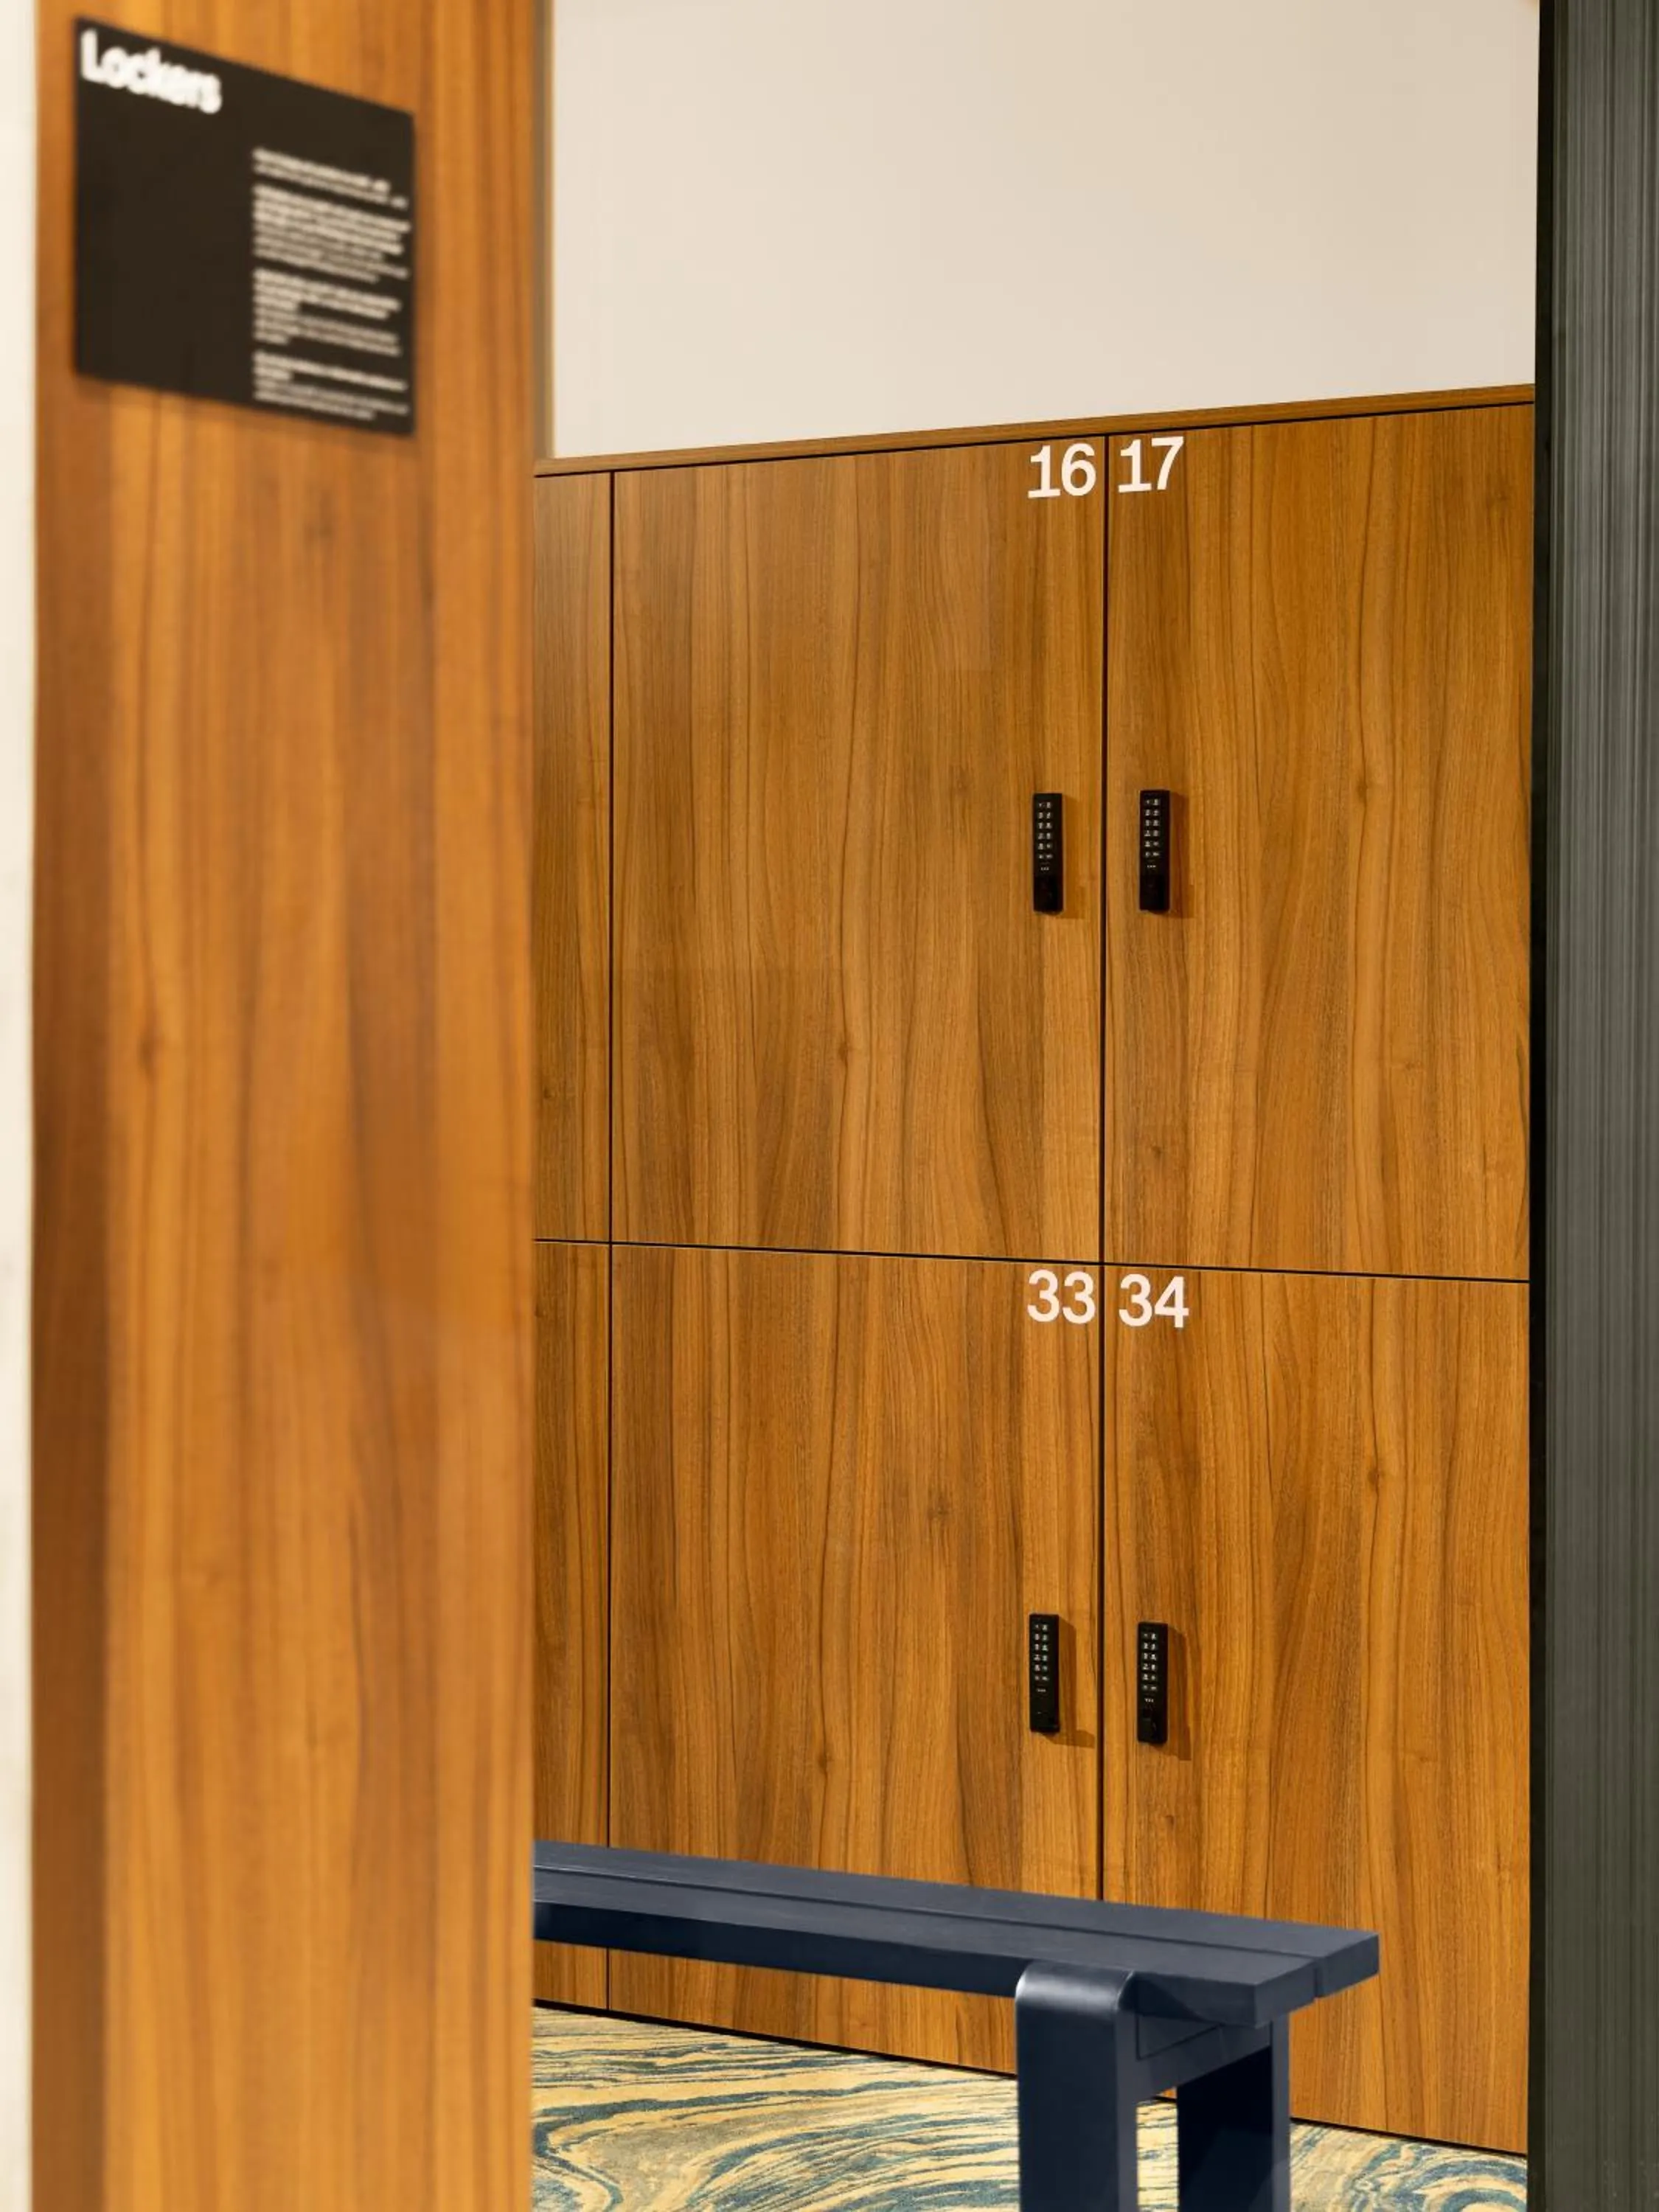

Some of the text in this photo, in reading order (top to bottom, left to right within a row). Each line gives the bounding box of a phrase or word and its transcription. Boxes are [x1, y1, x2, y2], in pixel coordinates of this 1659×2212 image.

[1028, 442, 1096, 499] 16
[1118, 436, 1184, 493] 17
[1027, 1269, 1096, 1324] 33
[1119, 1273, 1189, 1328] 34
